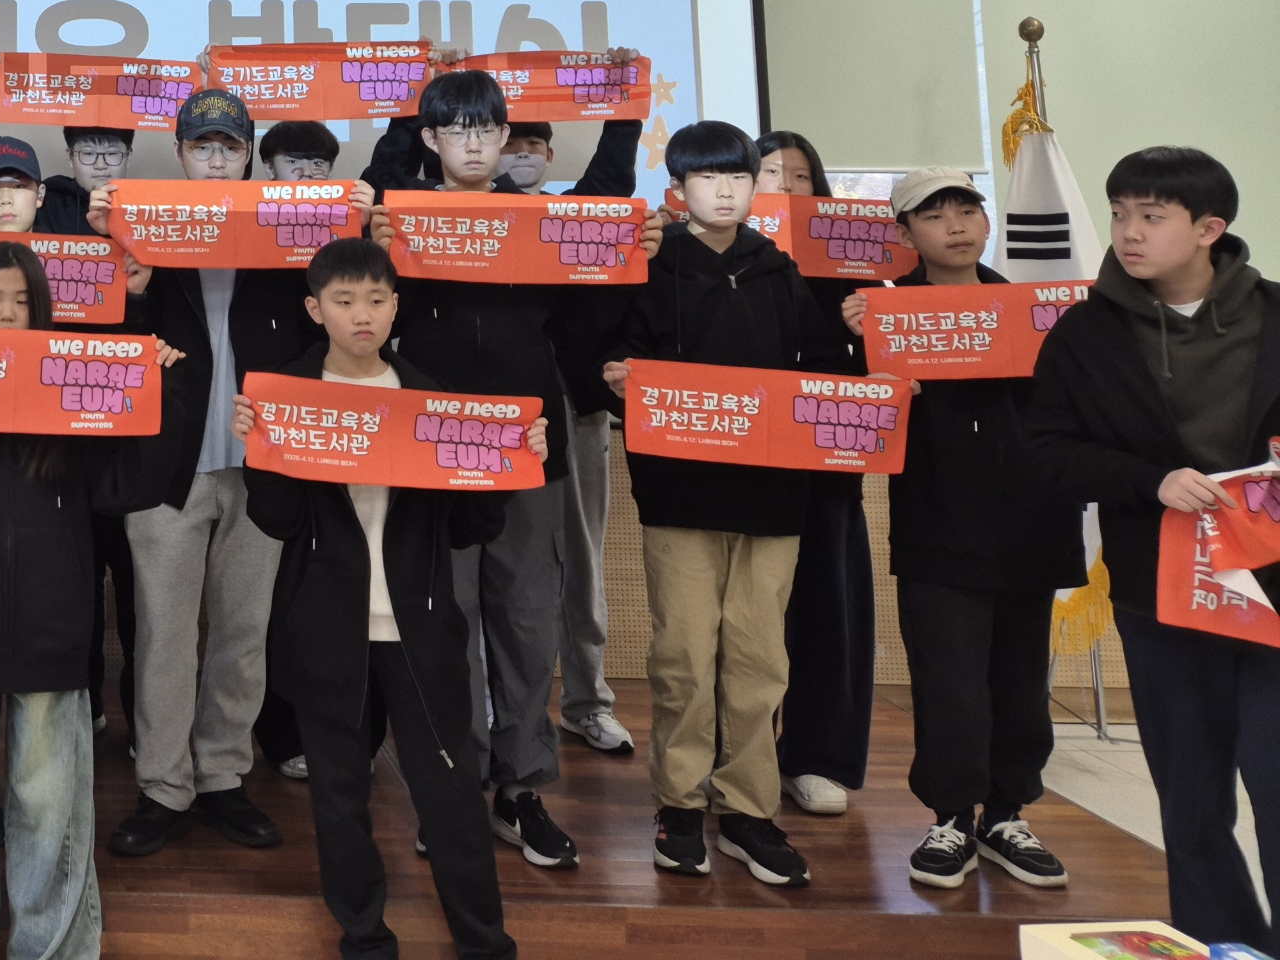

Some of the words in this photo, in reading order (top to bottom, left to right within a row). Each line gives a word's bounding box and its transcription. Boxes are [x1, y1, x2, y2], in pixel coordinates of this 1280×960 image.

[346, 47, 373, 58] we
[560, 54, 587, 65] we
[123, 63, 146, 75] we
[218, 66, 315, 82] 경기도교육청
[341, 60, 427, 82] NARAE
[556, 67, 637, 86] NARAE
[5, 72, 93, 89] 경기도교육청
[117, 76, 194, 100] NARAE
[359, 81, 415, 101] EUM!
[11, 89, 85, 106] 과천도서관
[573, 85, 629, 103] EUM!
[131, 96, 177, 118] EUM
[262, 186, 292, 199] we
[121, 204, 227, 222] 경기도교육청
[256, 202, 349, 226] NARAE
[547, 202, 579, 216] we
[818, 202, 848, 216] we
[130, 224, 220, 242] 과천도서관
[398, 215, 509, 237] 경기도교육청
[539, 218, 638, 244] NARAE
[30, 240, 60, 253] we
[407, 236, 501, 257] 과천도서관
[559, 242, 626, 267] EUM!
[827, 241, 892, 263] EUM!
[43, 257, 116, 284] ARAE
[1035, 287, 1071, 302] we
[875, 311, 998, 332] 경기도교육청
[49, 339, 83, 355] we
[886, 333, 992, 352] 과천도서관
[40, 357, 147, 389] NARAE
[801, 380, 835, 396] we
[61, 386, 132, 414] EUM!
[426, 399, 460, 414] we
[640, 386, 760, 414] 경기도교육청
[257, 400, 380, 432] 경기도교육청
[649, 409, 751, 435] 과천도서관
[793, 396, 899, 430] NARAE
[267, 424, 371, 455] 과천도서관
[414, 414, 524, 448] NARAE
[815, 423, 884, 453] EUM!
[436, 442, 513, 473] EUM!
